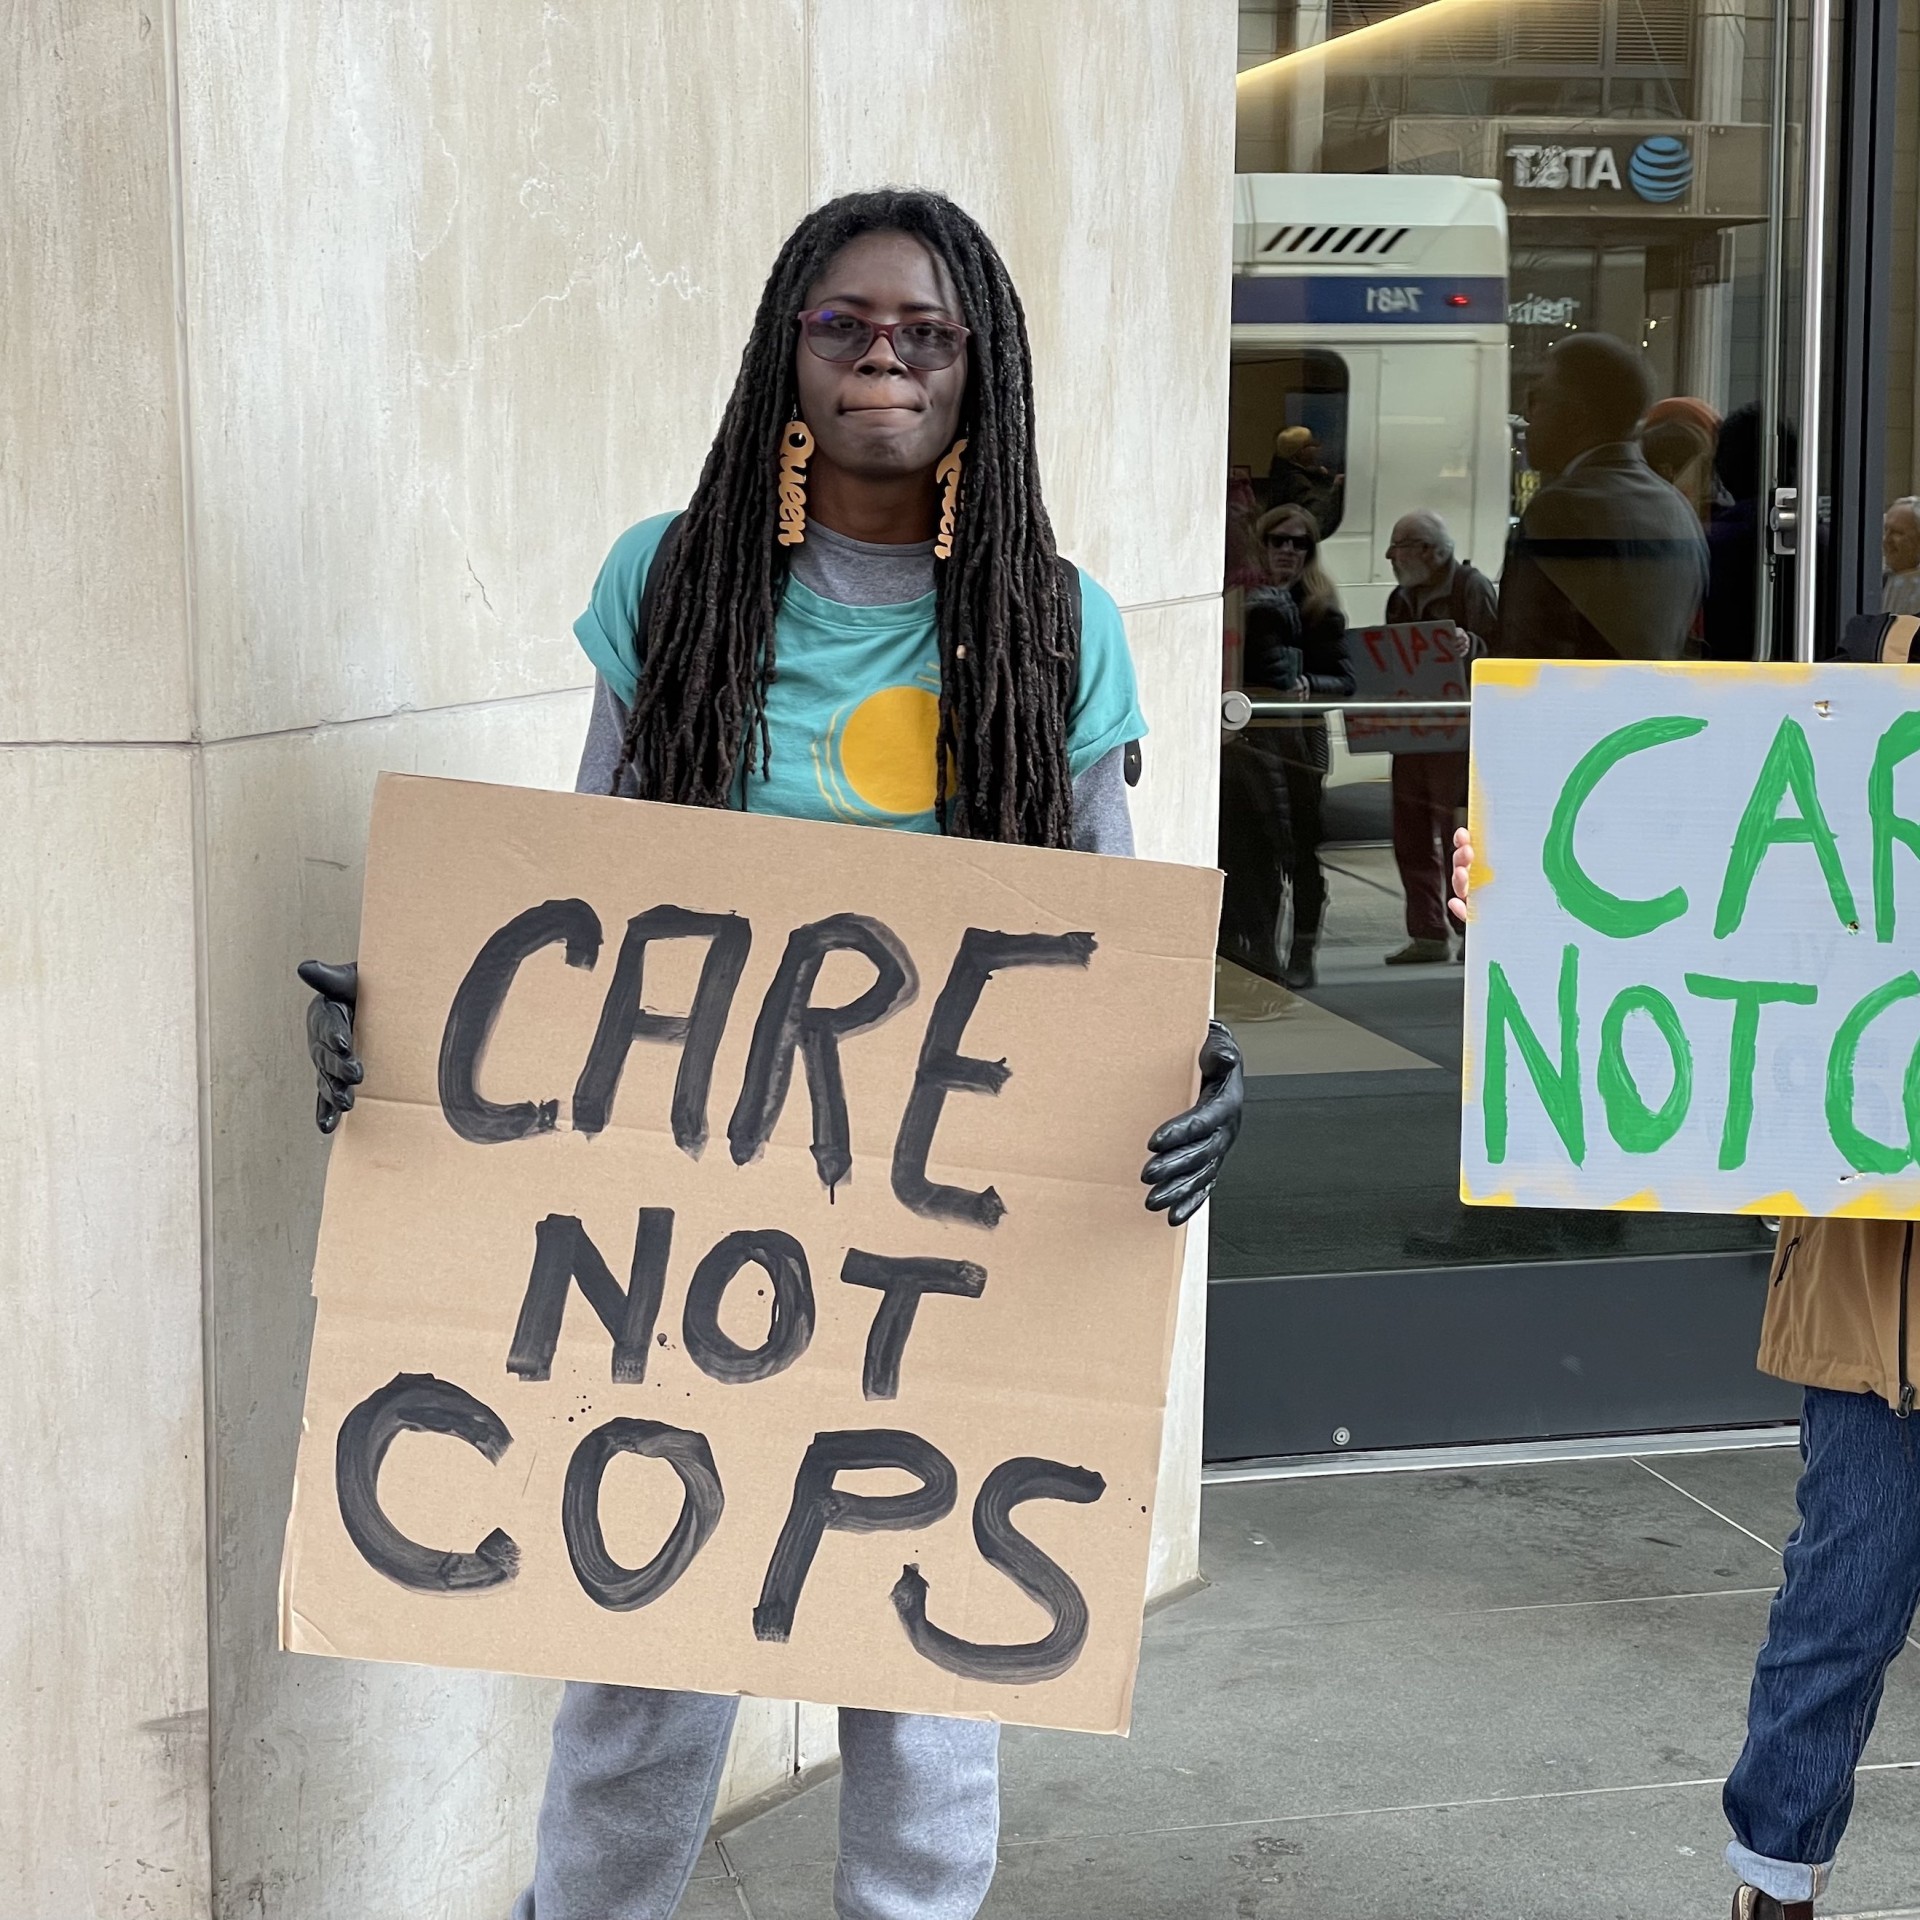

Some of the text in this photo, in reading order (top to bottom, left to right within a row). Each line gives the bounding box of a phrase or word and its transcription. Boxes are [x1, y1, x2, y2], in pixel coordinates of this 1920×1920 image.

[438, 898, 1098, 1229] CARE
[1483, 943, 1920, 1174] NOT C
[506, 1207, 987, 1401] NOT
[336, 1372, 1106, 1685] COPS
